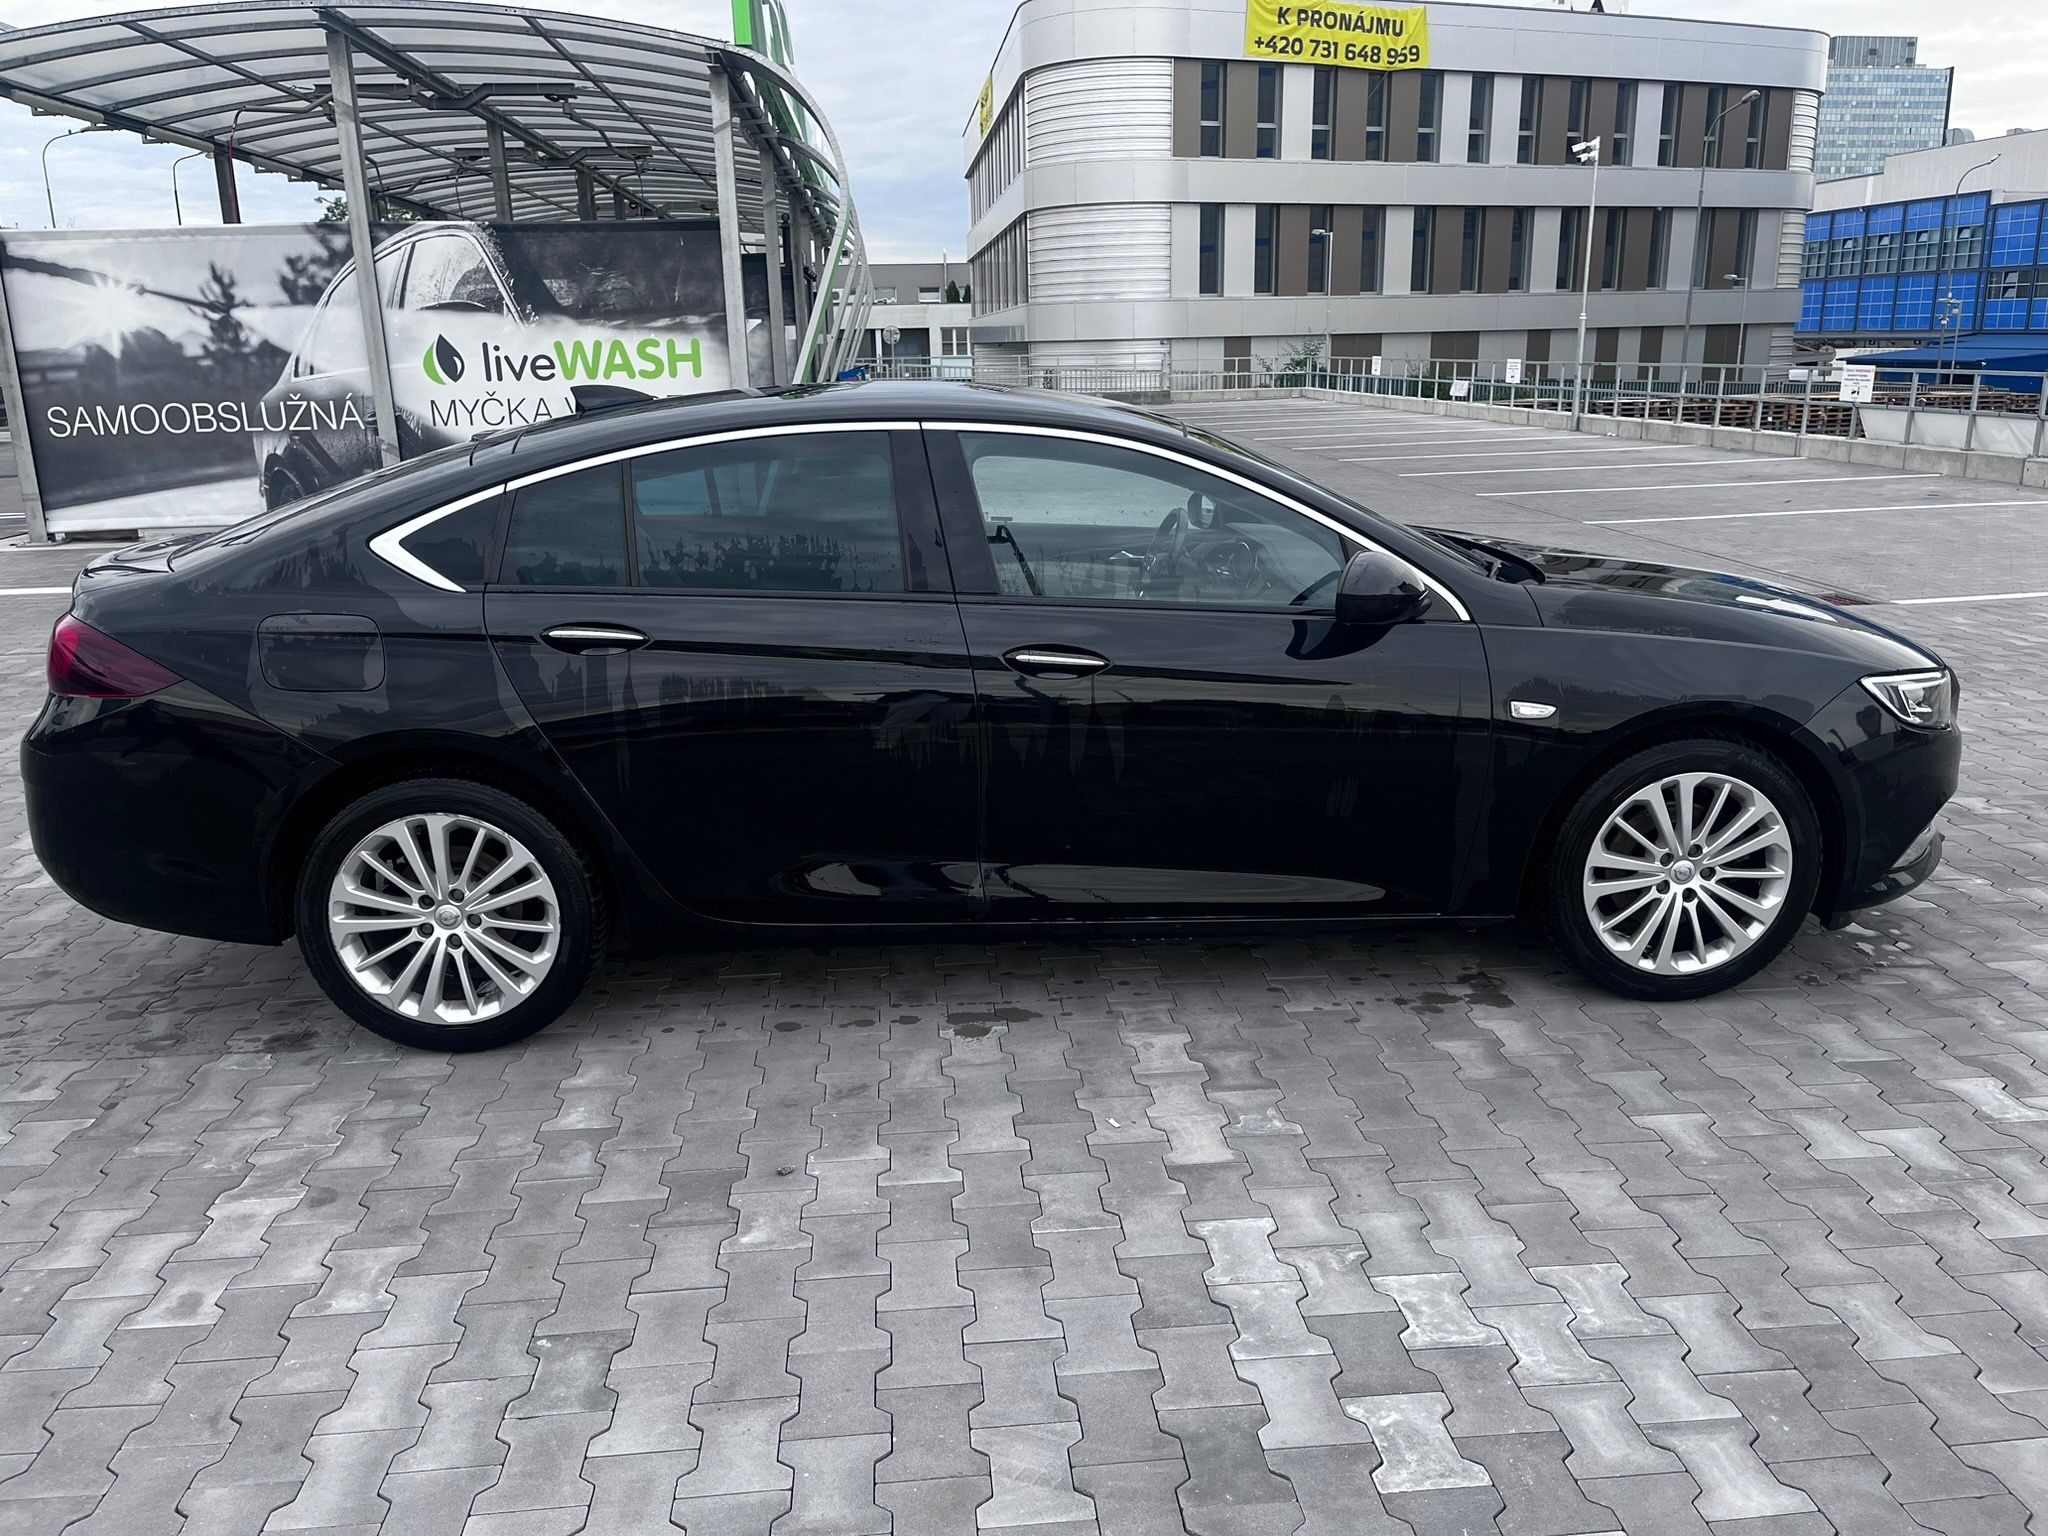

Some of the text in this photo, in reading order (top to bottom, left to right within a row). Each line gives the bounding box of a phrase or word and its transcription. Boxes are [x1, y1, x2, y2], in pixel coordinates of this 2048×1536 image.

[1277, 6, 1404, 37] K PRONÁJMU
[1254, 35, 1304, 56] +420
[1309, 39, 1338, 60] 731
[1345, 43, 1381, 64] 648
[482, 338, 702, 382] liveWASH
[47, 393, 365, 438] SAMOOBSLUŽNÁ
[430, 391, 552, 427] MYČKA
